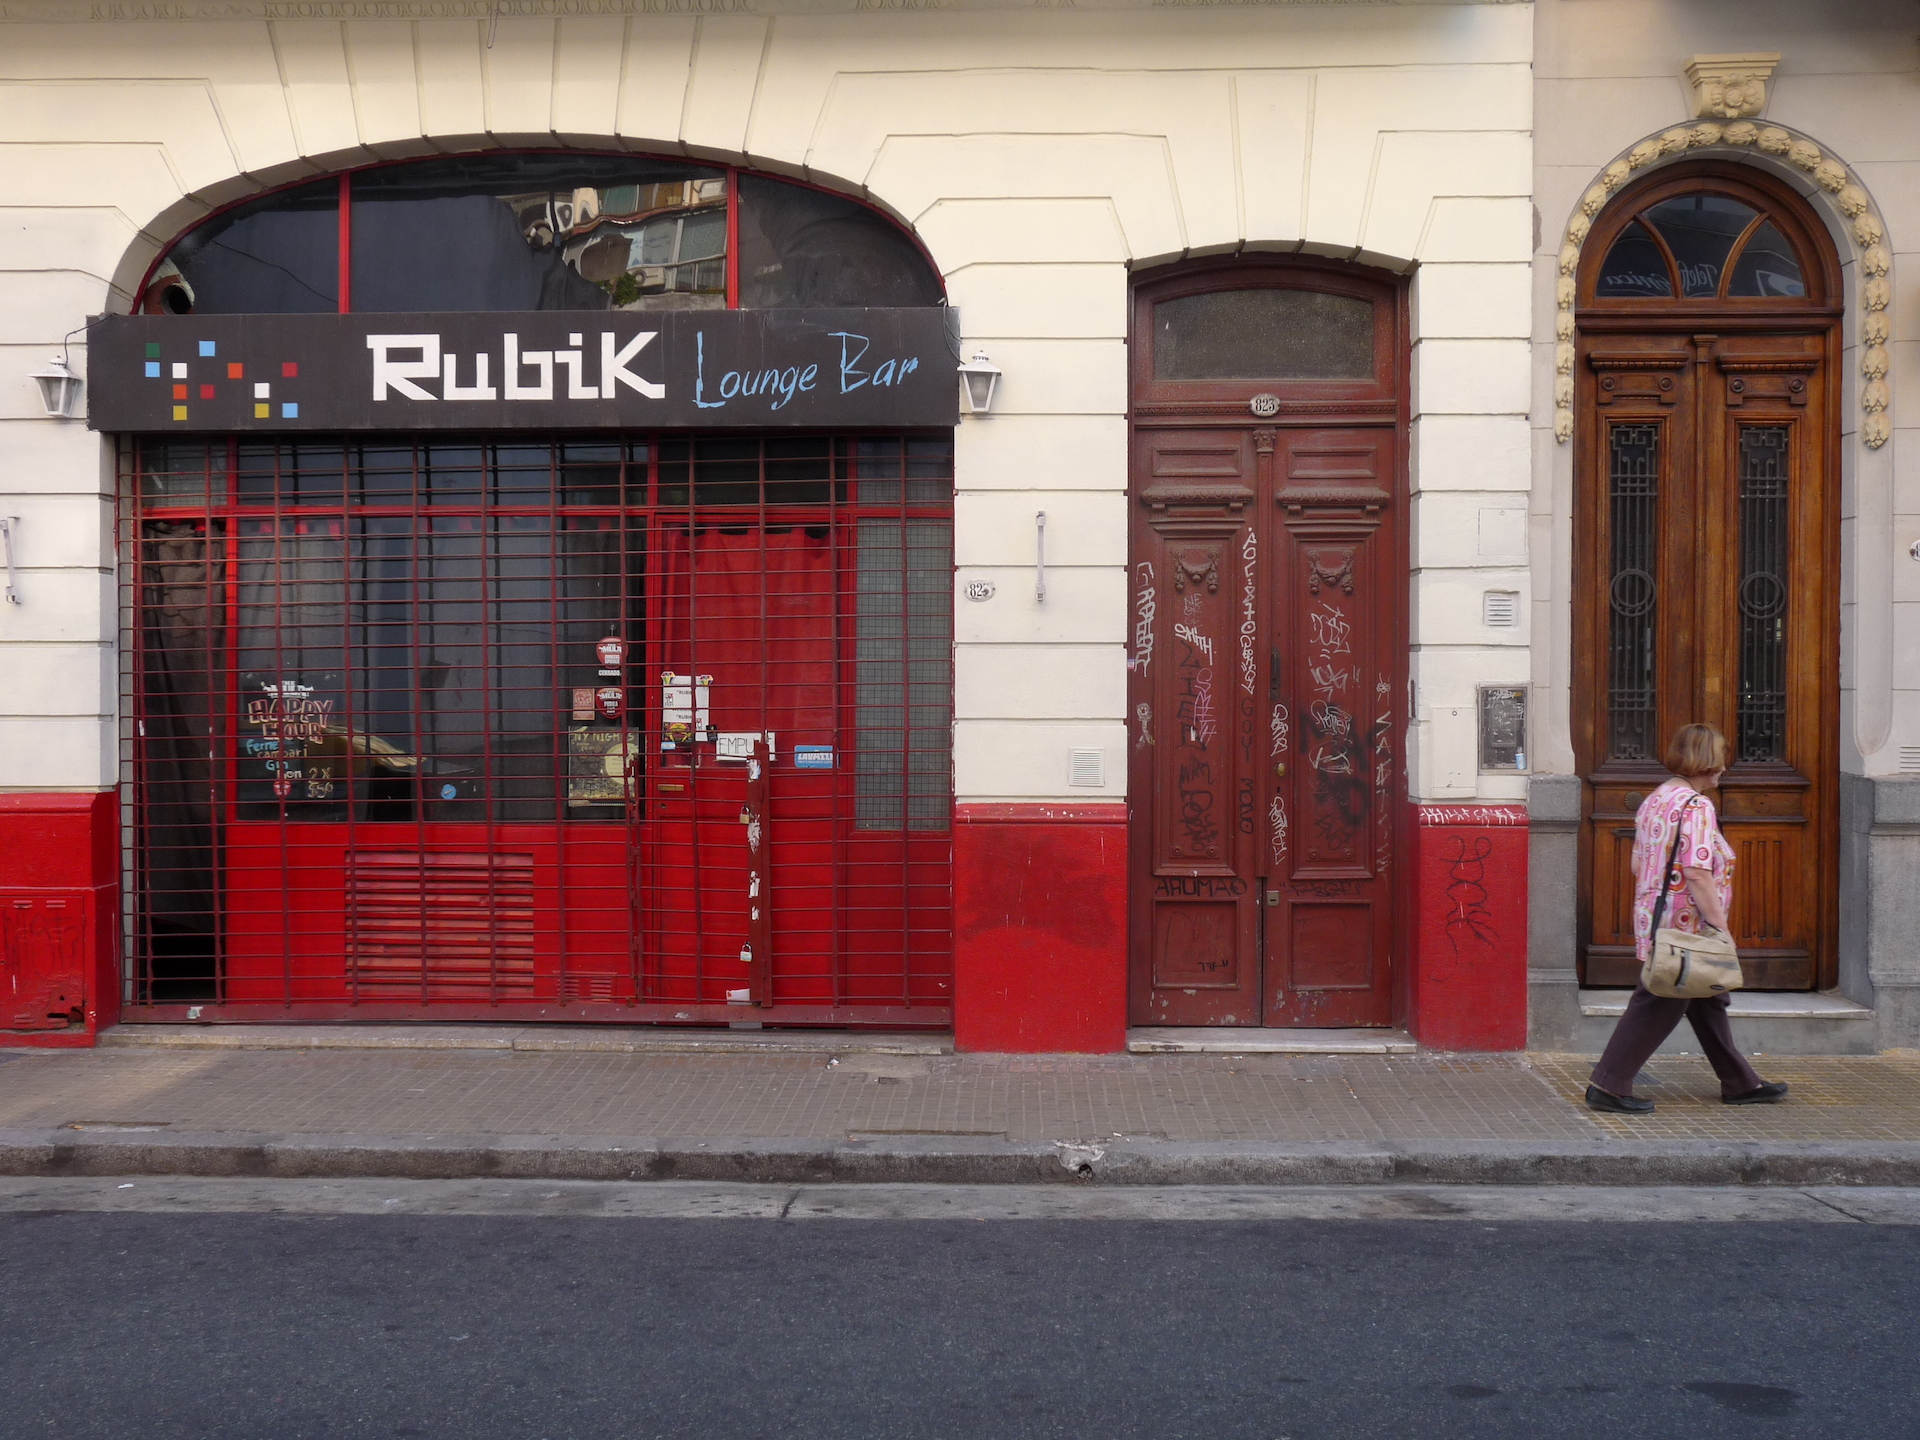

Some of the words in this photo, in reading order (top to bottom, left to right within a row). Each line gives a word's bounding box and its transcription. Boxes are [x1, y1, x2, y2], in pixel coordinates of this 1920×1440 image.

[694, 330, 818, 411] Lounge
[827, 331, 921, 394] Bar
[1255, 398, 1275, 412] 823
[248, 699, 334, 728] HAPPY
[592, 732, 635, 742] NIGHS
